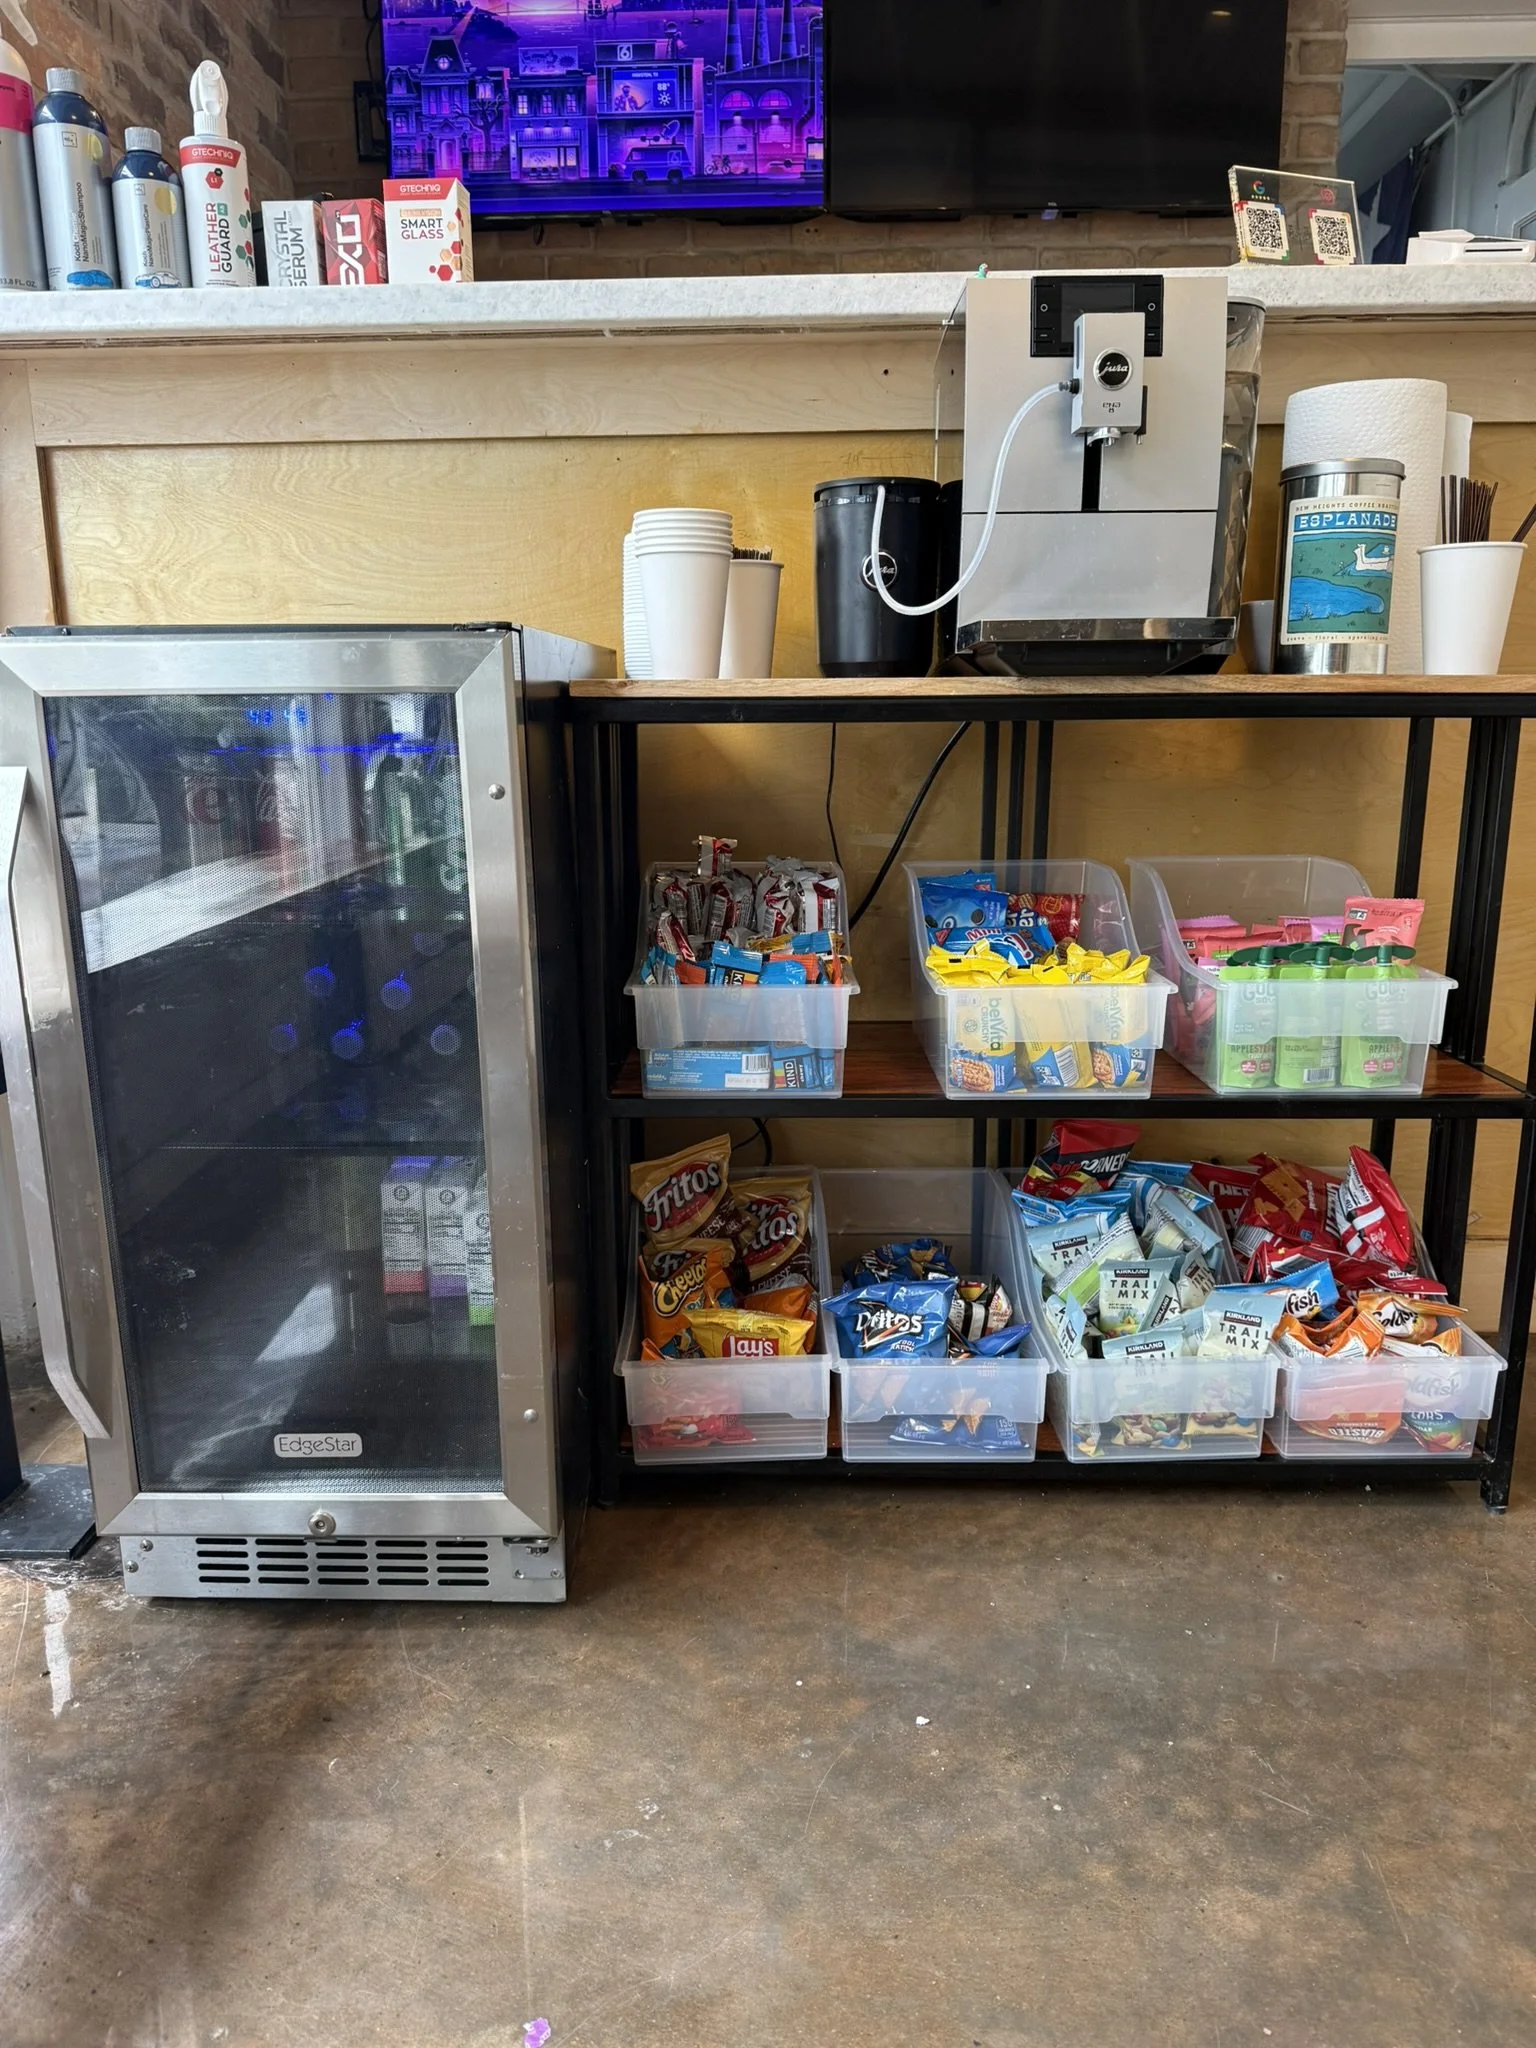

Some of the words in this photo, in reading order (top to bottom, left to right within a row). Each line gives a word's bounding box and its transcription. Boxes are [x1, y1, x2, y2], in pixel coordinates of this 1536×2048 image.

[191, 148, 234, 160] GTECHNIQ
[400, 184, 440, 193] GTECHNIQ
[76, 182, 89, 263] NanoMagicShampoo
[401, 218, 444, 229] SMART
[206, 202, 221, 272] LEATHER
[401, 230, 445, 240] GLASS
[74, 240, 82, 262] Koch
[218, 218, 232, 273] GUARD
[1300, 512, 1396, 528] ESPLANADE
[785, 1061, 797, 1088] KIND
[643, 1162, 721, 1232] Fritos
[1118, 1290, 1149, 1299] MIX
[1227, 1312, 1262, 1324] KIRKLAND
[1219, 1323, 1272, 1341] TRAIL
[730, 1335, 774, 1358] Lay's
[1128, 1342, 1164, 1353] KIRKLAND
[1225, 1336, 1260, 1350] MIX
[278, 1436, 357, 1456] EdgeStar
